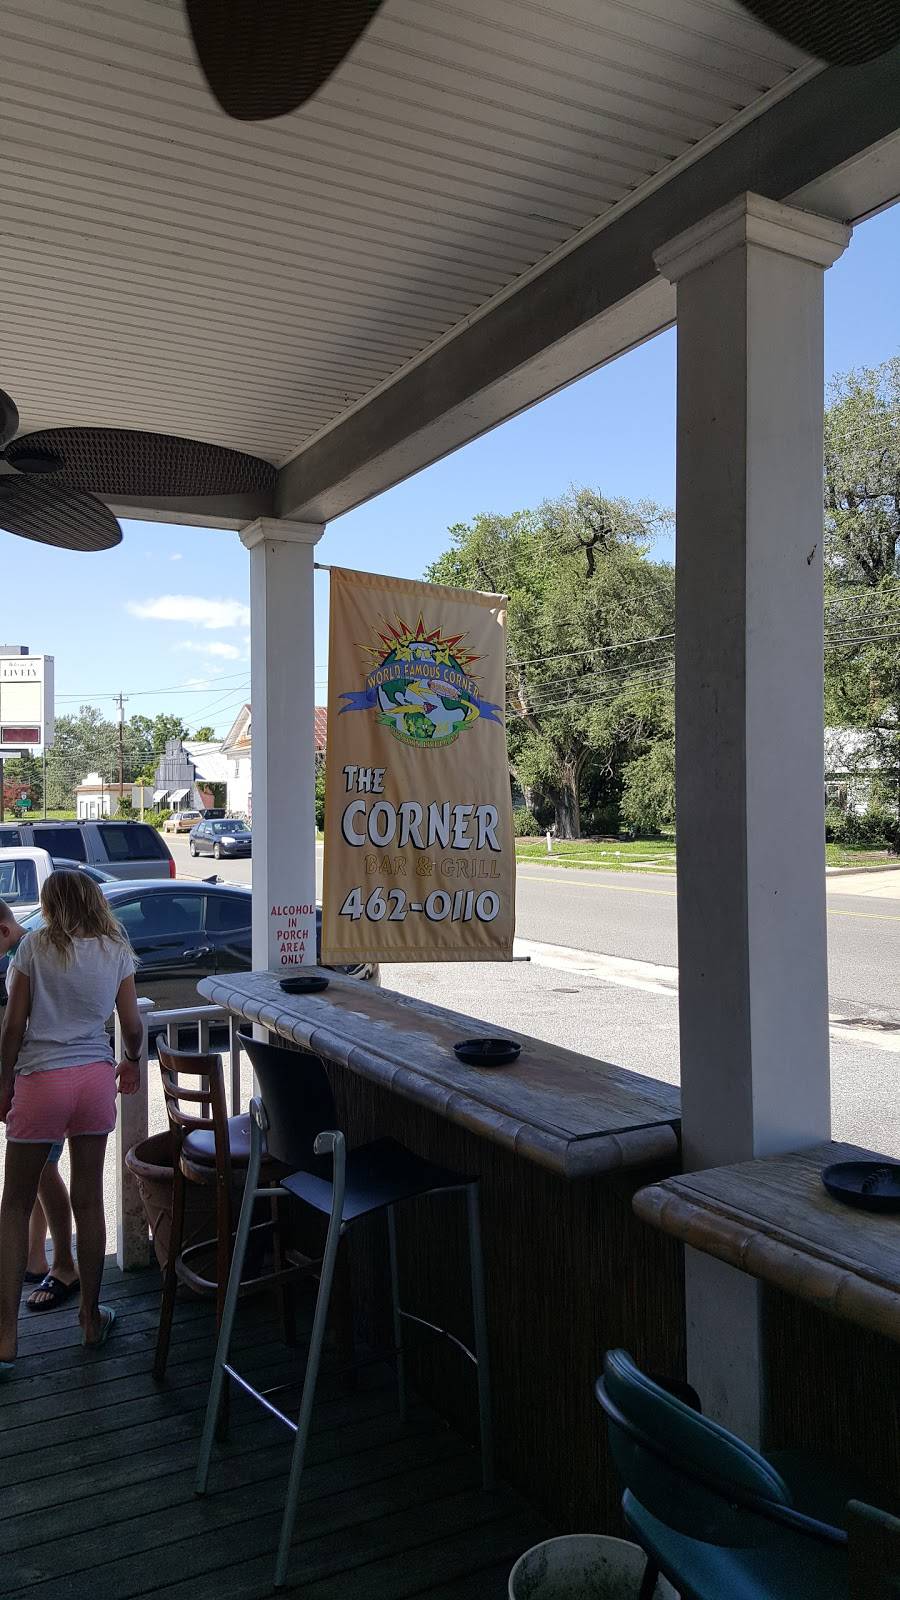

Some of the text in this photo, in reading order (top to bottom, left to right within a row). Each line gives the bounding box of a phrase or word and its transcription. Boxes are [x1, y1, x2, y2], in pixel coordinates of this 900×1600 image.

[367, 665, 401, 689] WORLD
[404, 663, 441, 679] FAMOUS
[443, 668, 480, 699] CORNER
[343, 764, 386, 794] THE
[341, 799, 502, 852] CORNER
[364, 853, 501, 879] BAR & GRILL
[271, 904, 315, 916] ALCOHOL
[339, 885, 500, 922] 462-0110
[288, 917, 297, 928] IN
[276, 929, 309, 941] PORCH
[280, 941, 305, 953] AREA
[281, 953, 305, 965] ONLY
